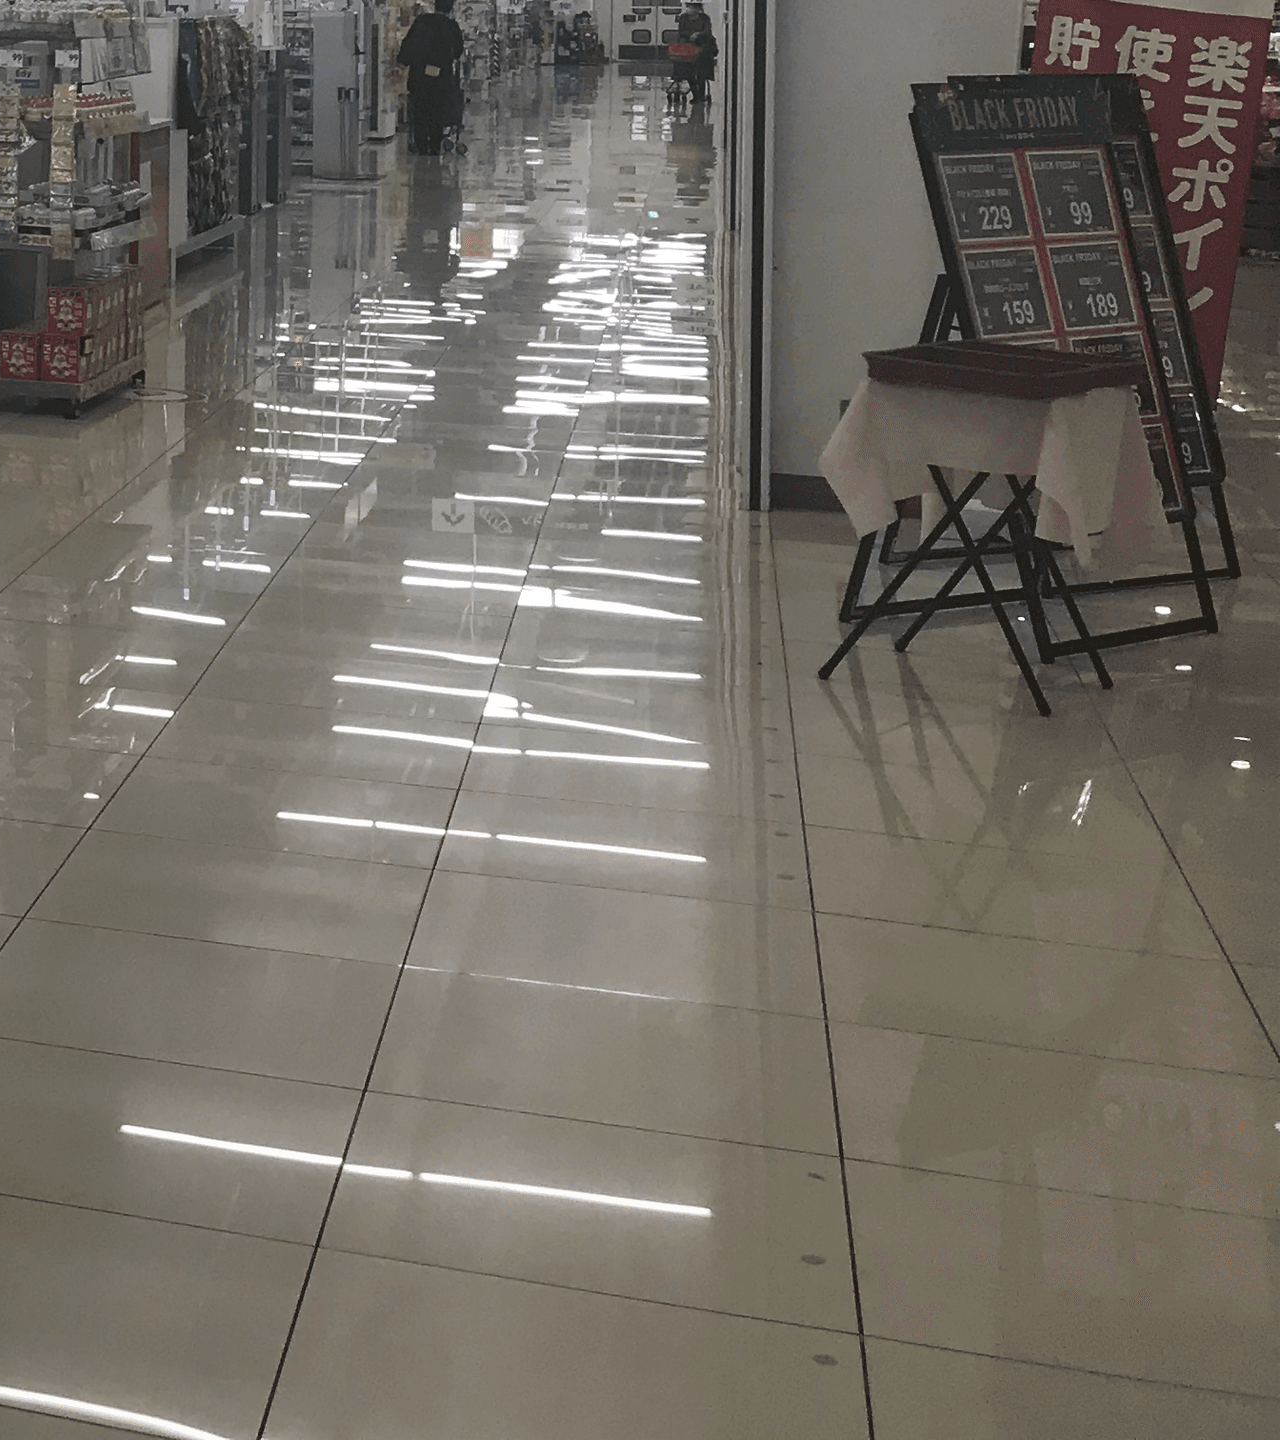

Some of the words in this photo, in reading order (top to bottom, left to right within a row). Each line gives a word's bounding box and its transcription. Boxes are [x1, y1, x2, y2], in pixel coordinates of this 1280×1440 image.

[15, 69, 32, 79] Edy
[947, 98, 1011, 131] BLACK
[1013, 96, 1079, 128] FRIDAY
[979, 205, 1013, 230] 229
[1070, 201, 1093, 225] 99
[1003, 300, 1035, 325] 159
[1086, 292, 1118, 318] 189
